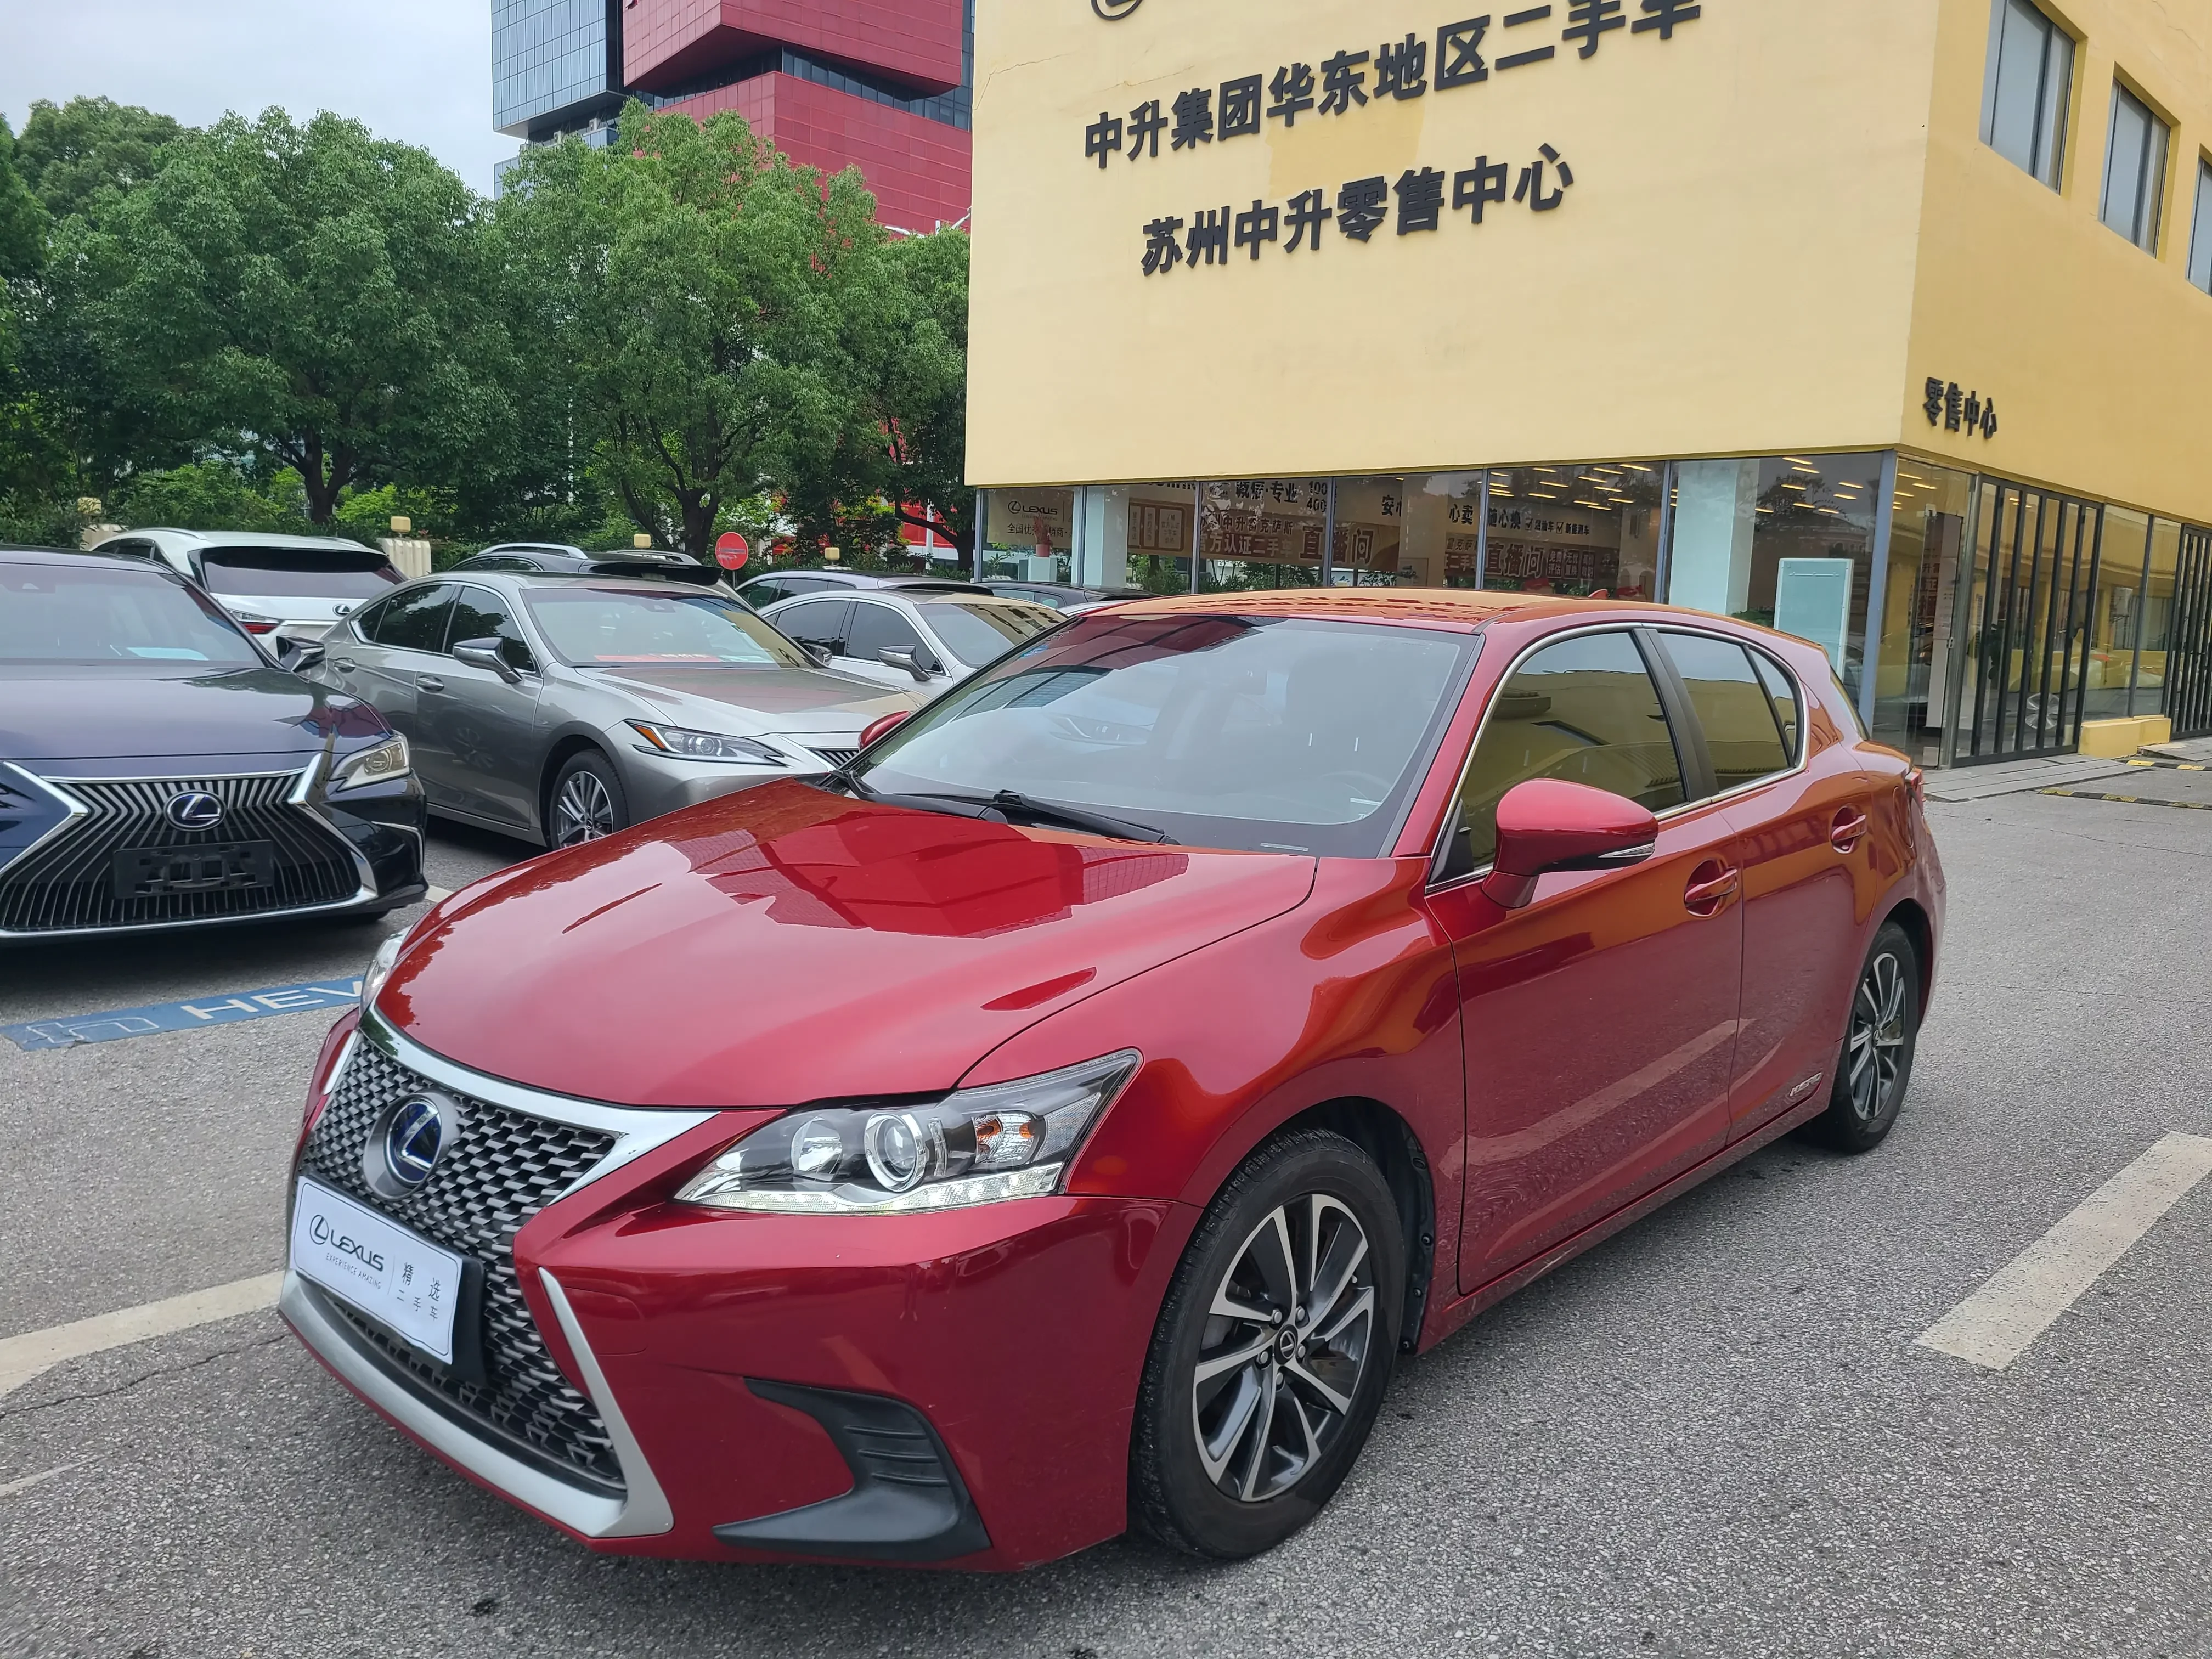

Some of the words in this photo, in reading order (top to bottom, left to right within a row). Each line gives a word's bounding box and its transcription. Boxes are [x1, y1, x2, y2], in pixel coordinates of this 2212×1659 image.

[1085, 0, 1701, 169] 中升集团华东地区二手车
[1140, 143, 1573, 276] 苏州中升零售中心
[1923, 377, 1997, 439] 零售中心
[1022, 505, 1058, 515] LEXUS
[1299, 524, 1374, 565] 直播间
[1485, 541, 1545, 579] 直播间
[179, 980, 363, 1020] HEV
[330, 1229, 385, 1272] LEXUS
[325, 1252, 358, 1276] EXPERIENCE
[358, 1271, 382, 1290] AMAZING
[401, 1262, 442, 1302] 精选
[397, 1289, 439, 1321] 二手车
